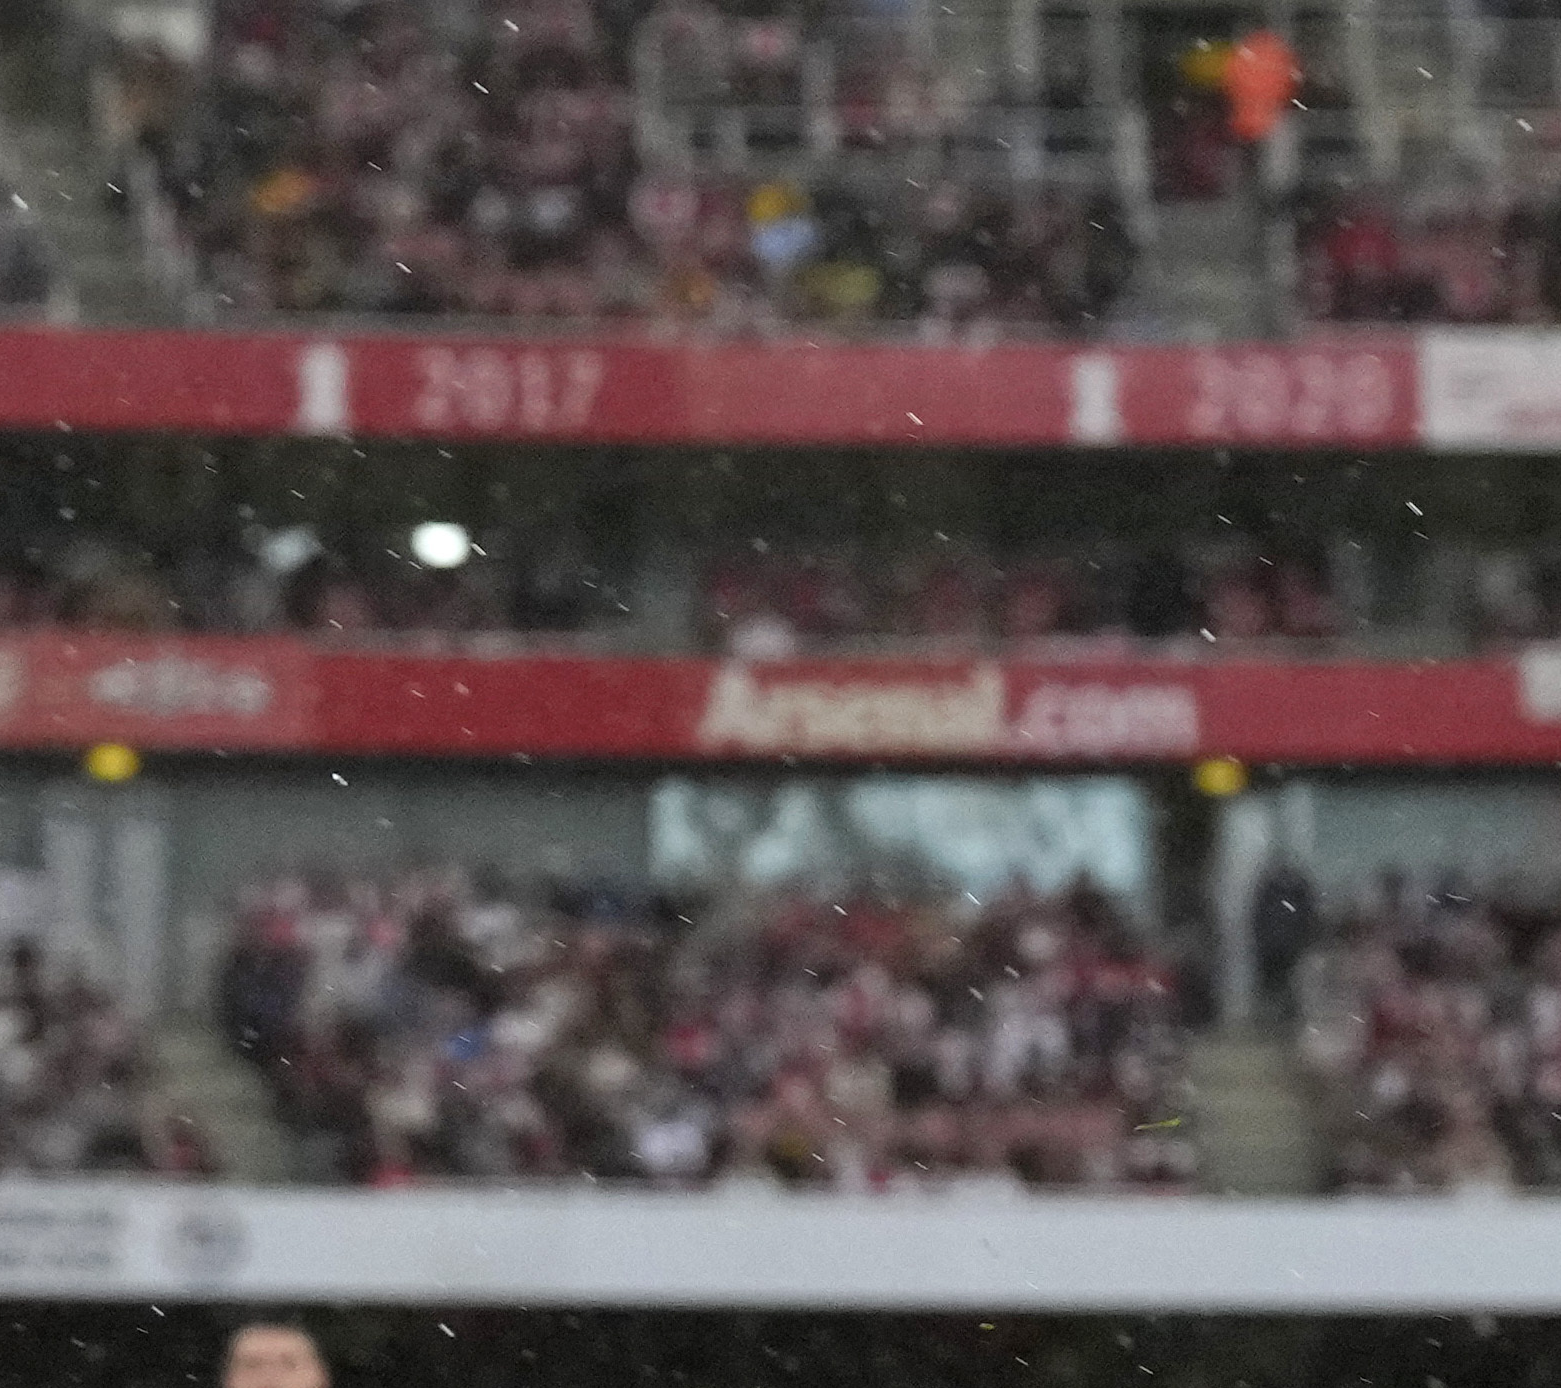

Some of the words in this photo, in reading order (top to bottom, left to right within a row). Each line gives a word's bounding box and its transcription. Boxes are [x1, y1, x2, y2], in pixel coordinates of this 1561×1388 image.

[413, 346, 604, 430] 2017
[1187, 353, 1393, 434] 2020
[698, 661, 1199, 756] Arsenal.com
